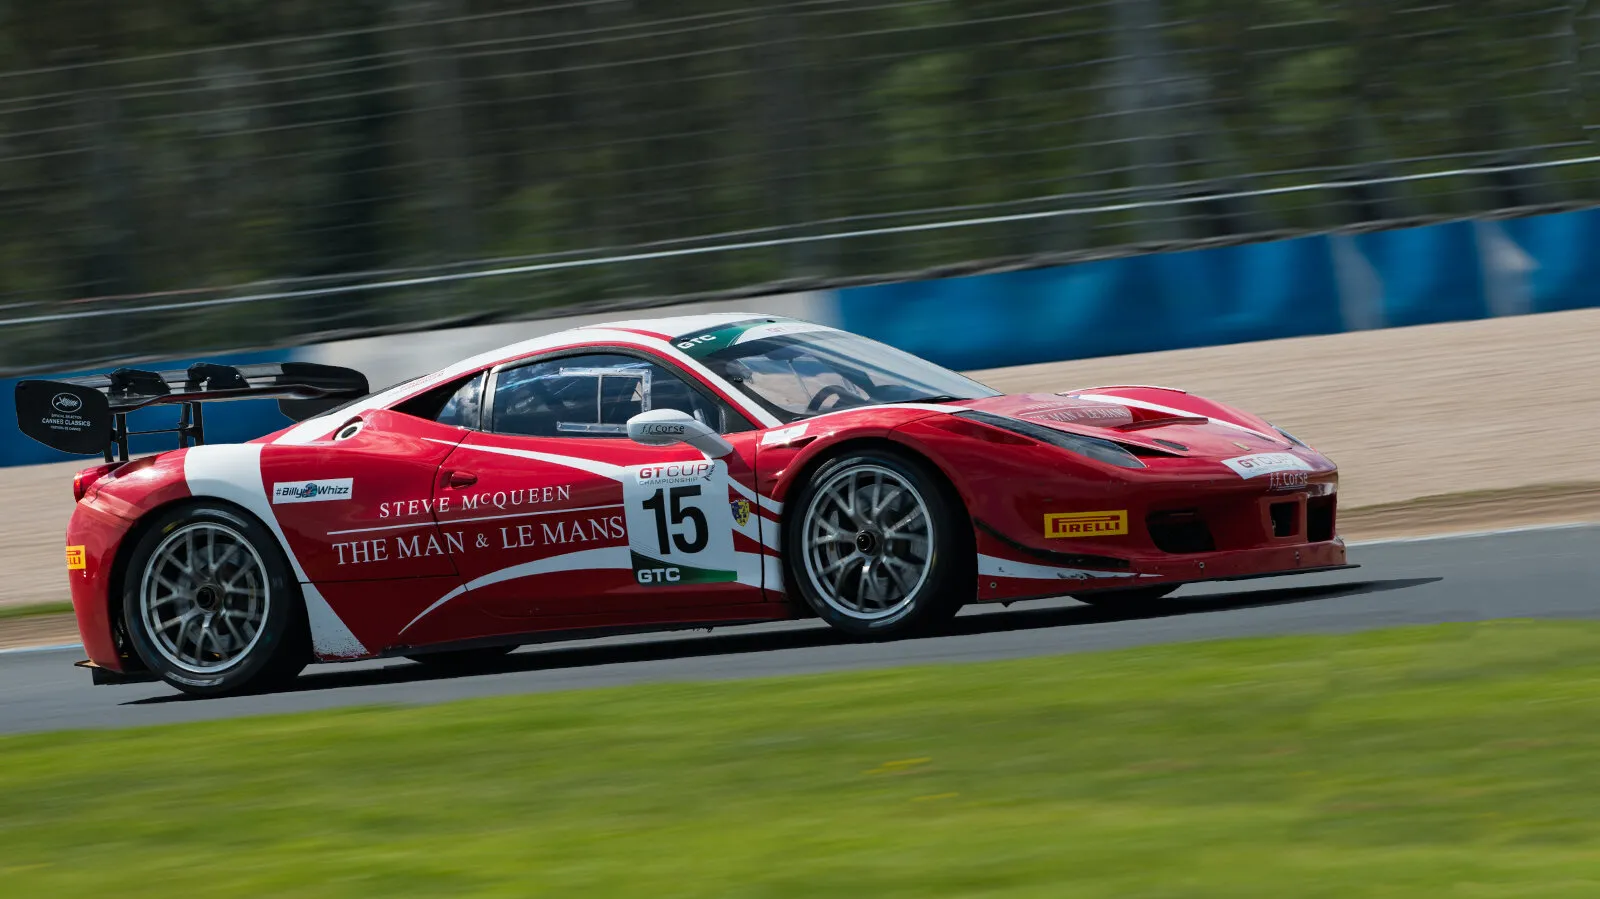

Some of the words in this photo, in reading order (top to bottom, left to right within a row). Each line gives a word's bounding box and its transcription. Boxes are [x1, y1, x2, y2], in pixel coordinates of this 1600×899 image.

[676, 334, 717, 349] GTC
[41, 417, 64, 425] CANNES
[64, 419, 91, 427] CLASSICS
[655, 424, 685, 434] Corse
[639, 466, 664, 479] GT
[666, 463, 709, 477] CUP
[639, 477, 698, 486] CHAMPIONSHIP
[1283, 472, 1308, 486] Corse
[317, 485, 349, 494] Whizz
[379, 497, 450, 518] STEVE
[641, 485, 709, 555] 15
[1051, 515, 1120, 533] PIRELLI
[332, 538, 389, 566] THE
[395, 531, 465, 559] MAN
[475, 532, 490, 548] &
[499, 524, 535, 550] LE
[540, 515, 625, 545] MANS
[637, 567, 681, 583] GTC
